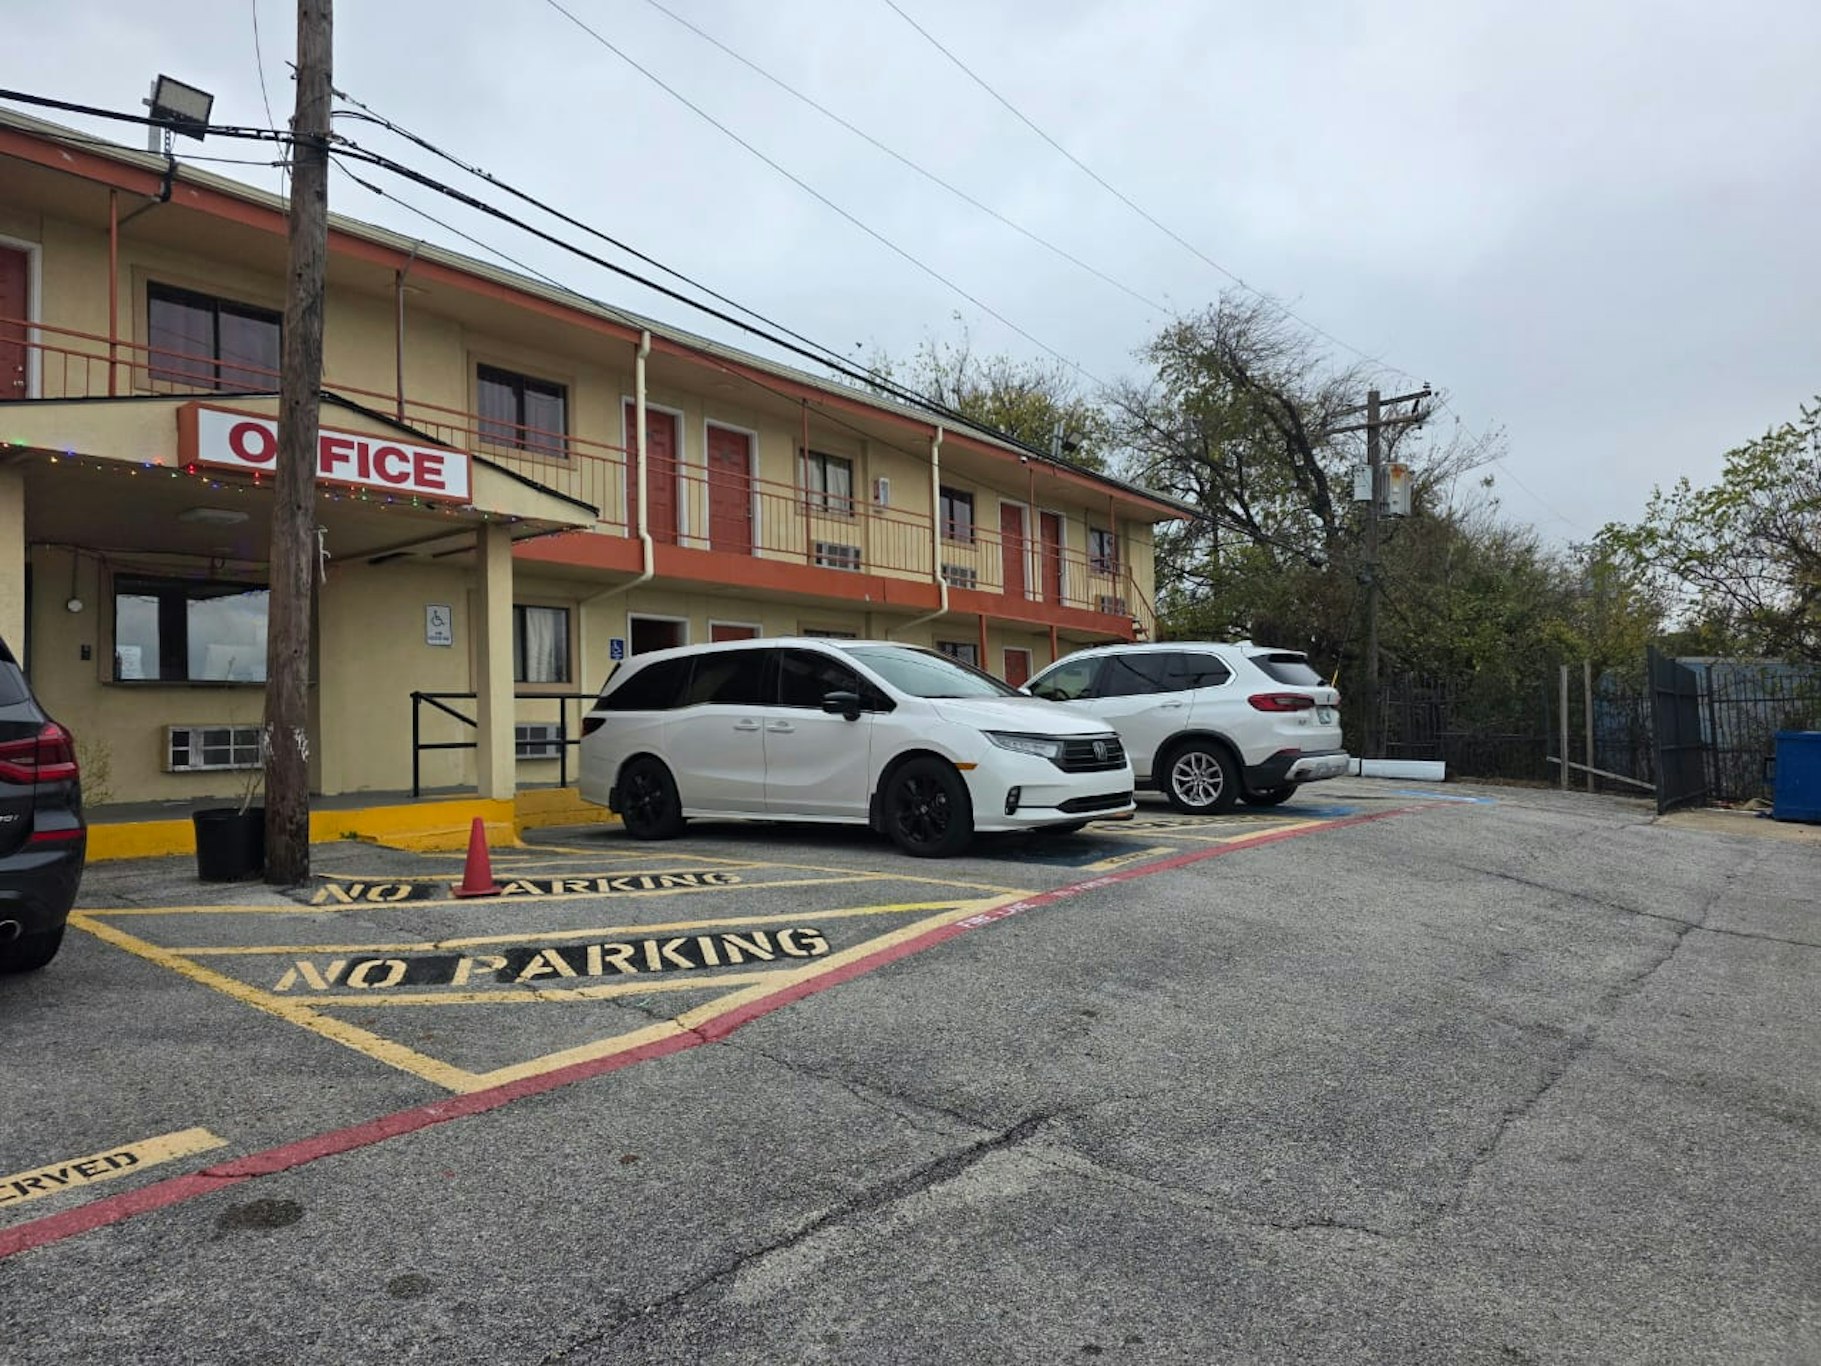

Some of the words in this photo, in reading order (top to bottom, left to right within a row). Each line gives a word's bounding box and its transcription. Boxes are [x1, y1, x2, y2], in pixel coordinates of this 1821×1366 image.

[229, 422, 446, 490] OFICE
[311, 883, 413, 904] NO
[450, 871, 742, 898] ARKING
[274, 958, 409, 991] NO
[450, 927, 831, 985] PARKING
